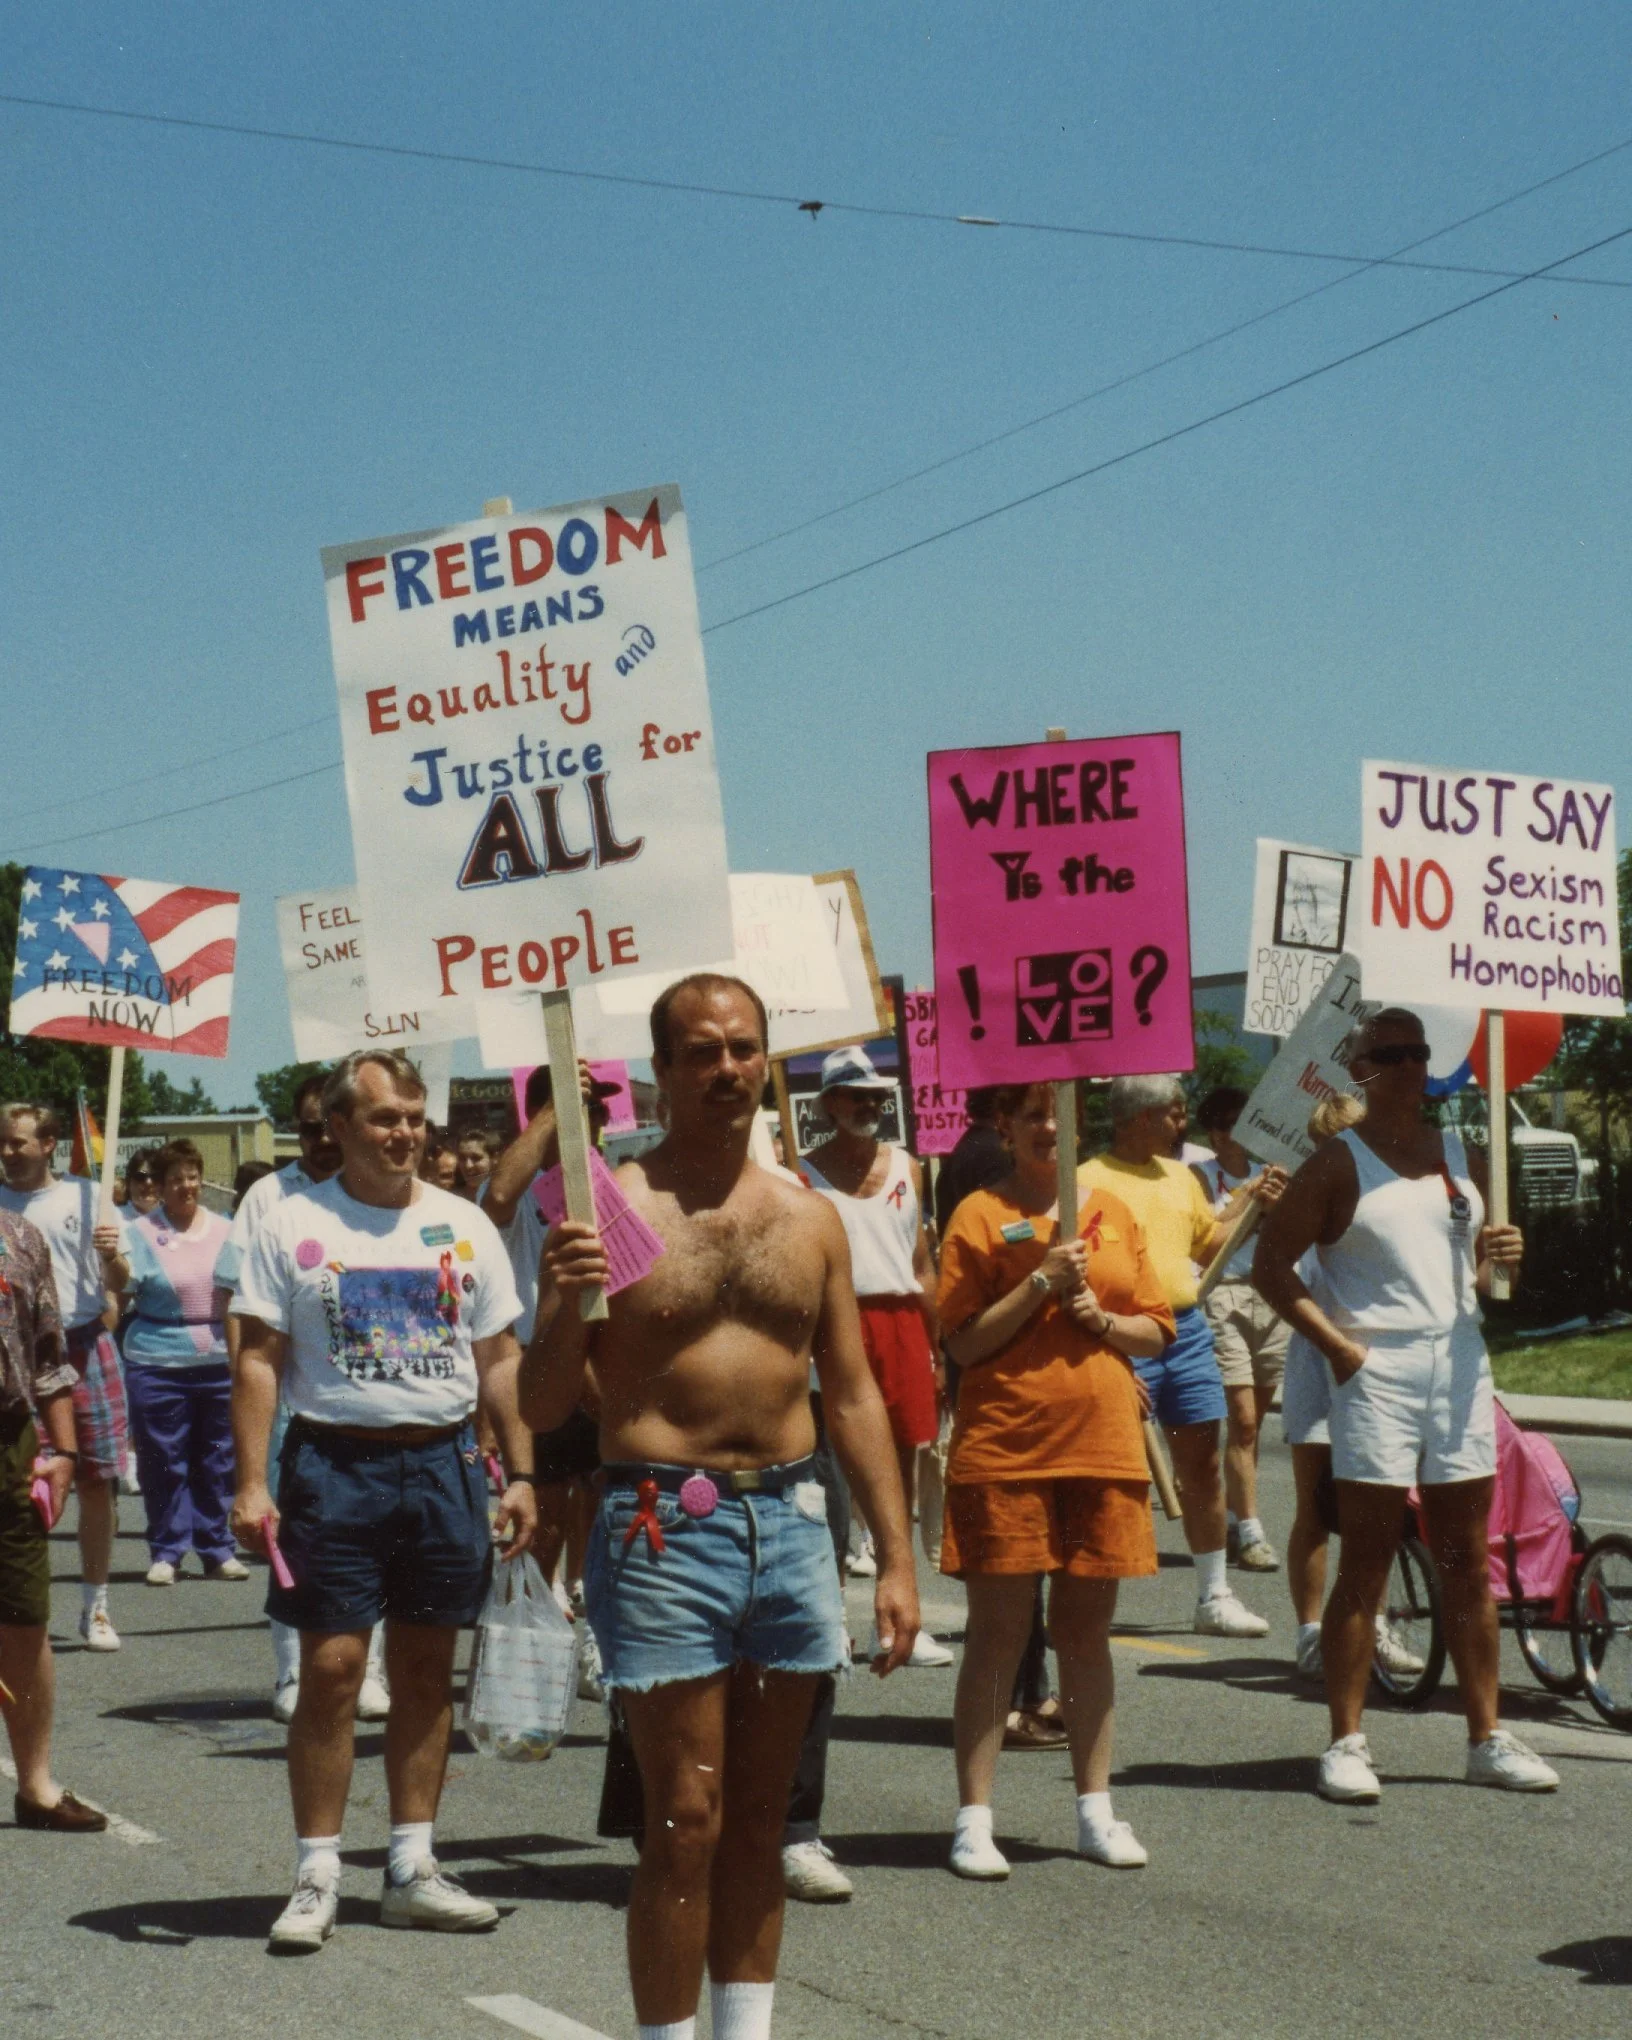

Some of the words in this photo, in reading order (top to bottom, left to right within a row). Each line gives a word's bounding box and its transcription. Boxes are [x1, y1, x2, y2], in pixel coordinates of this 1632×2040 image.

[345, 497, 667, 623] FREEDOM
[453, 585, 605, 647] MEANS
[615, 623, 657, 676] and
[403, 734, 604, 806] Justice
[639, 723, 702, 760] for
[949, 758, 1139, 829] WHERE
[1378, 770, 1517, 838] JUST
[1527, 782, 1613, 851] SAY
[456, 770, 646, 891] ALL
[1059, 853, 1135, 896] the
[1372, 855, 1454, 931] NO
[1483, 855, 1604, 907] Sexism
[299, 903, 360, 932] FEEL
[1483, 901, 1607, 946] Racism
[41, 967, 193, 1007] FREEDOM
[1256, 948, 1306, 981] PRAY
[1311, 955, 1336, 982] FO
[1263, 976, 1300, 1006] END
[1451, 942, 1624, 1001] Homophobia
[88, 999, 161, 1034] NOW
